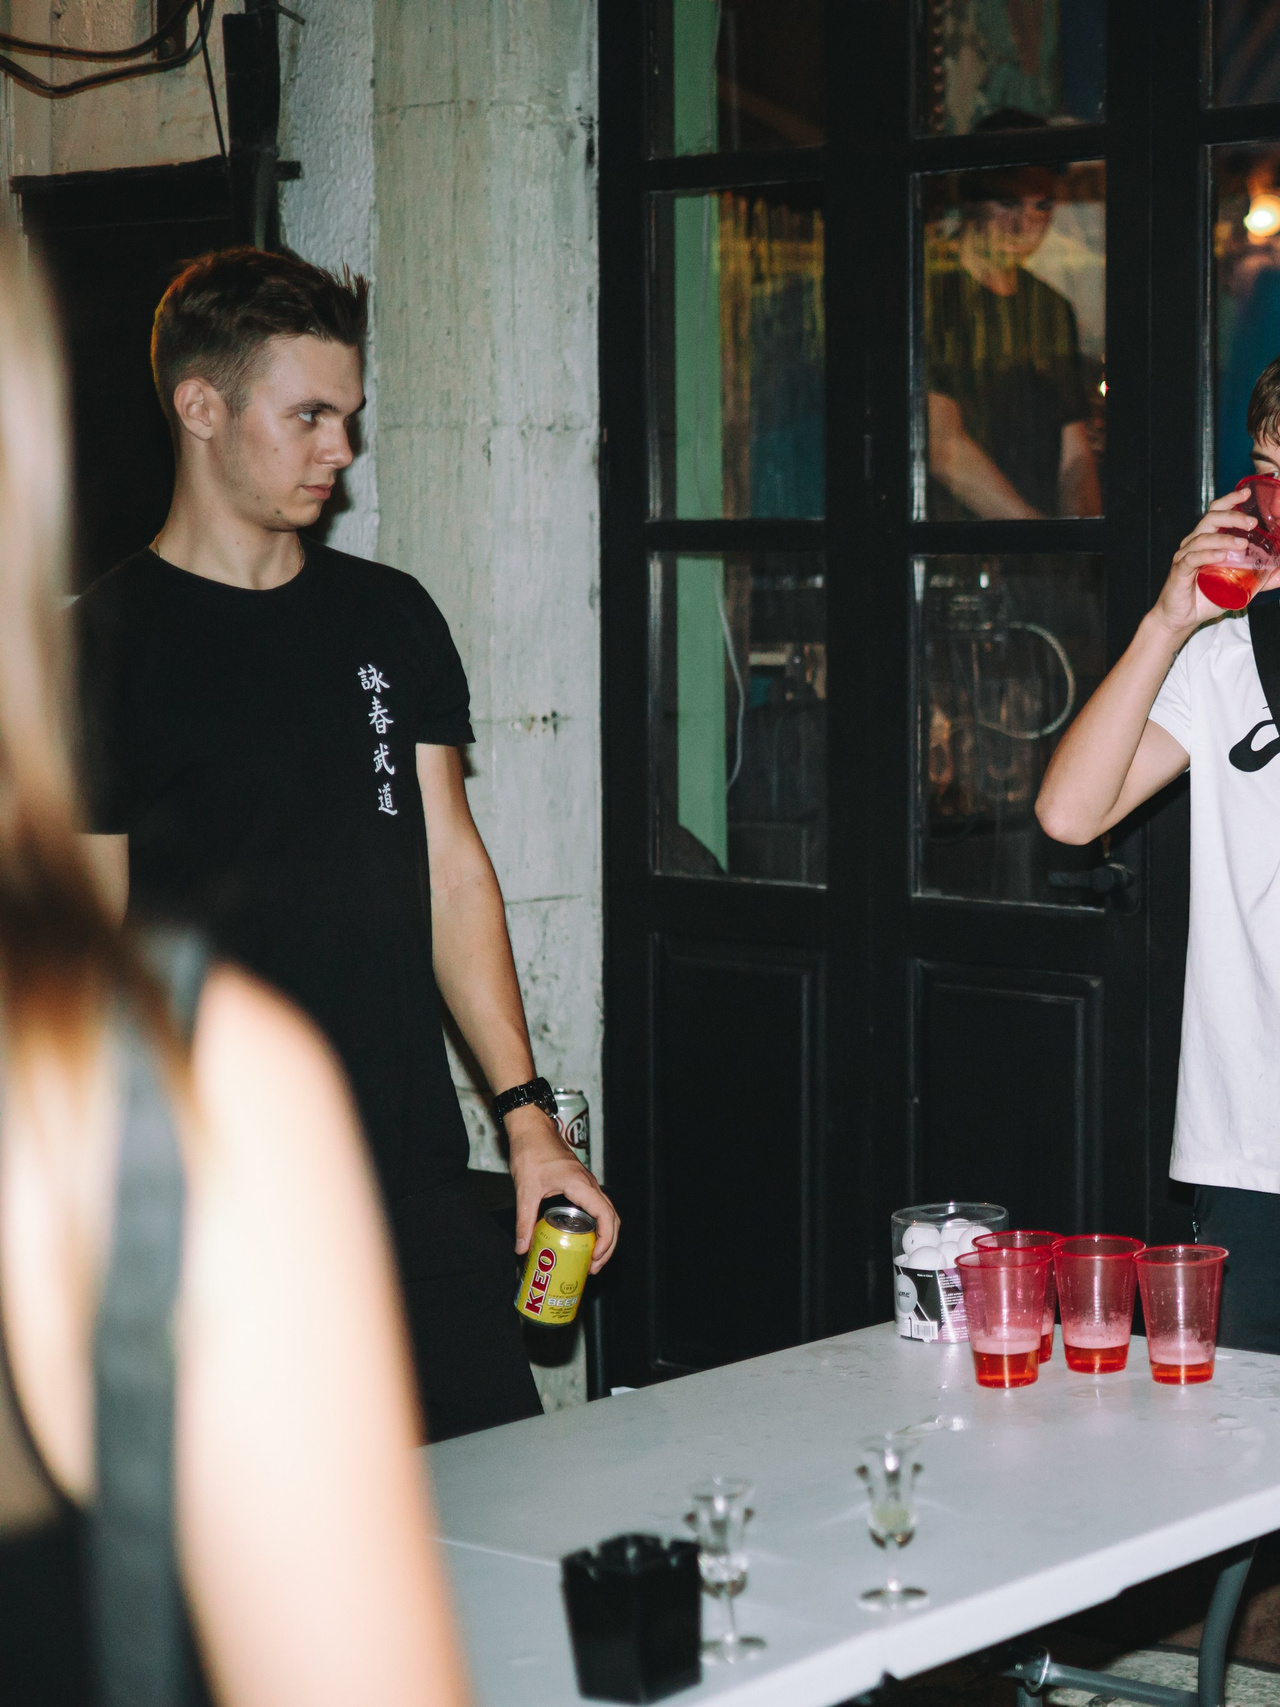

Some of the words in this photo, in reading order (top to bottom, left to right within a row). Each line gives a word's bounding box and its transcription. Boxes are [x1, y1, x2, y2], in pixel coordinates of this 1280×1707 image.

[357, 663, 398, 816] 詠春武道
[524, 1247, 556, 1316] KEO
[547, 1296, 579, 1307] BEER
